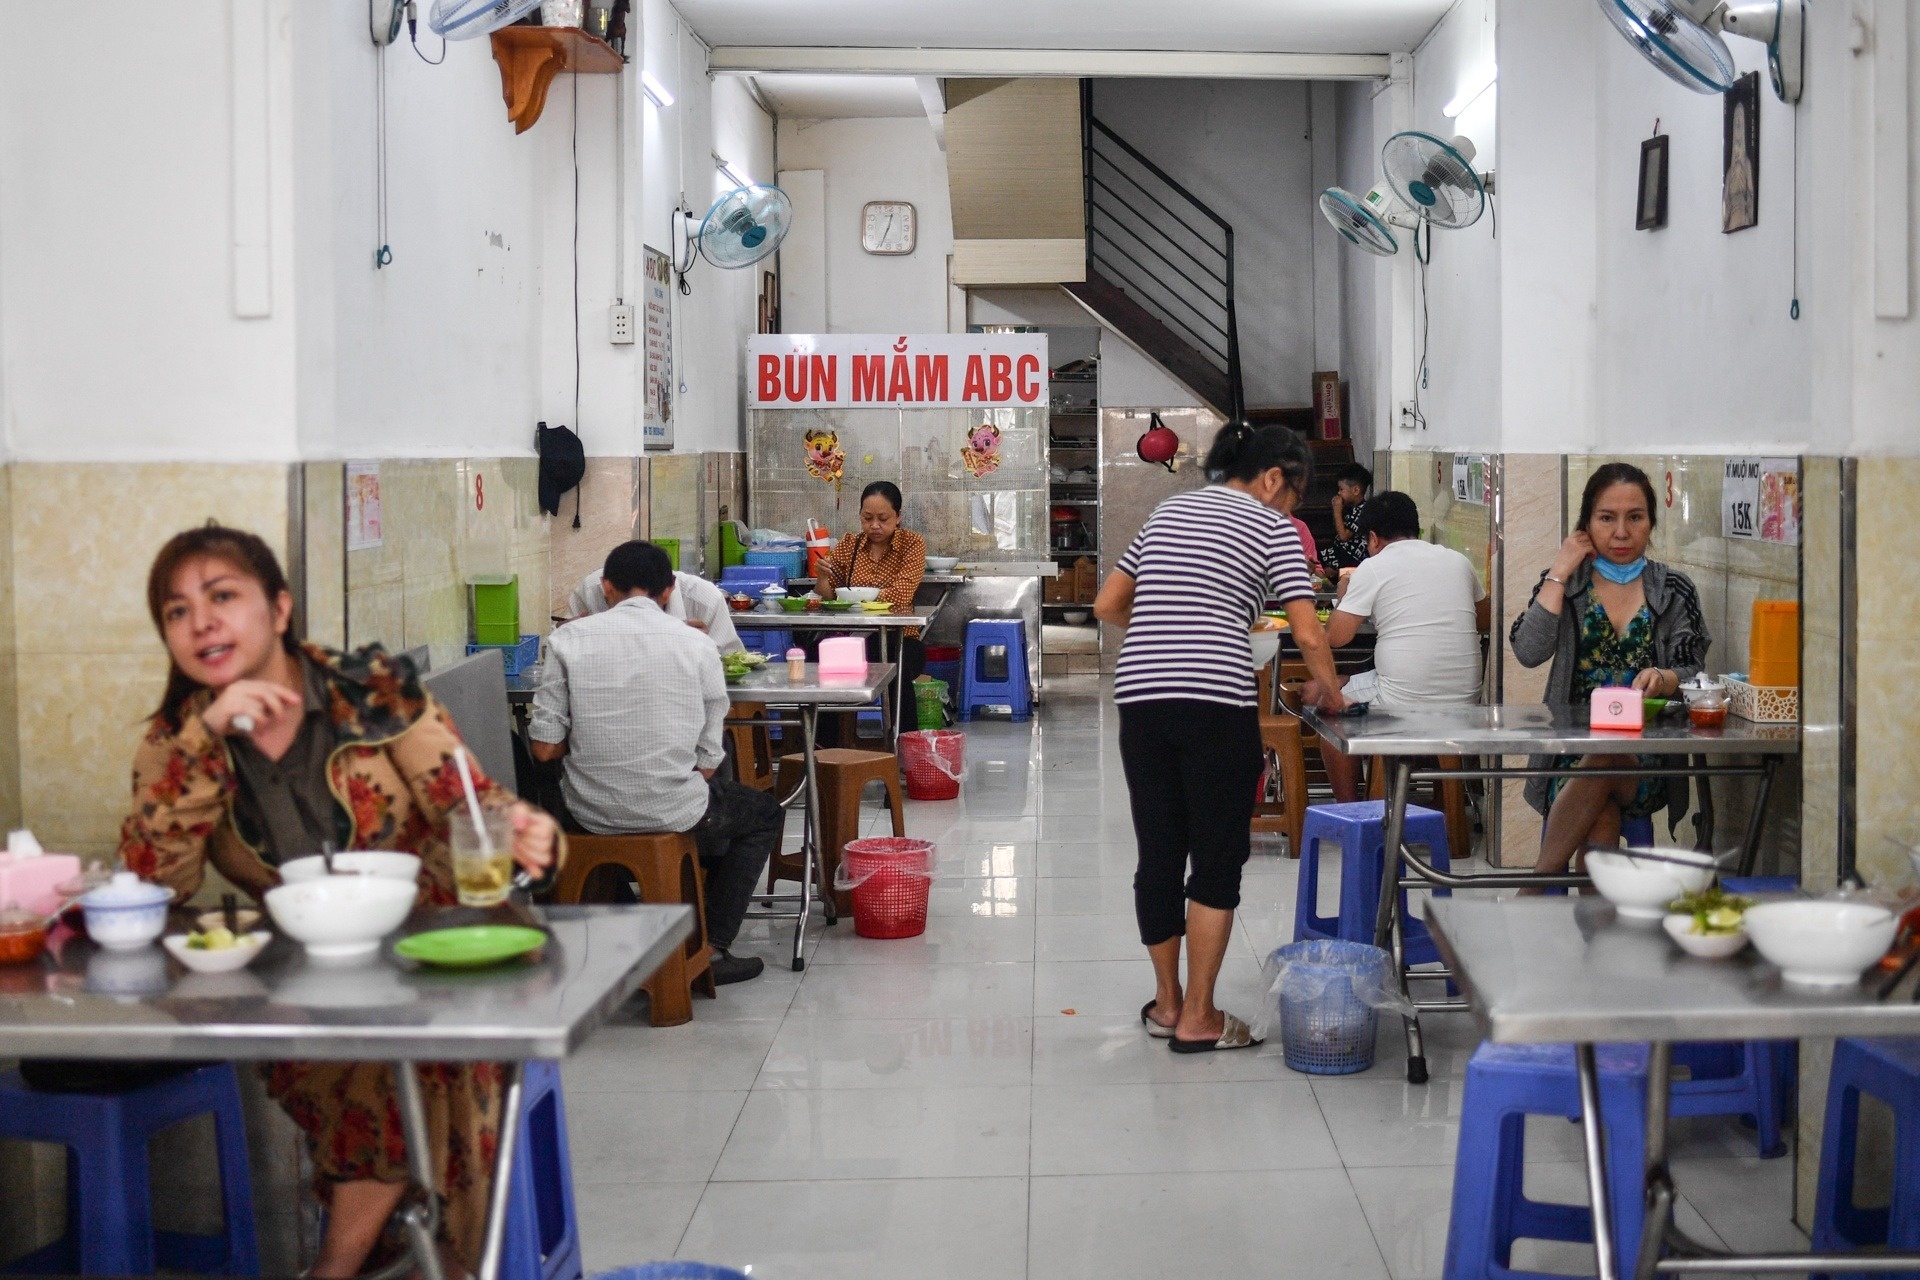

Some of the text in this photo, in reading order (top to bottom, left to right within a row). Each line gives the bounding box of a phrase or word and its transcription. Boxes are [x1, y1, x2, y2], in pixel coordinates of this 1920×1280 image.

[852, 336, 948, 402] MẮM
[962, 354, 1040, 402] ABC
[1437, 461, 1442, 484] 5
[1665, 471, 1673, 508] 3
[476, 473, 484, 511] 8
[1732, 501, 1752, 530] 15K
